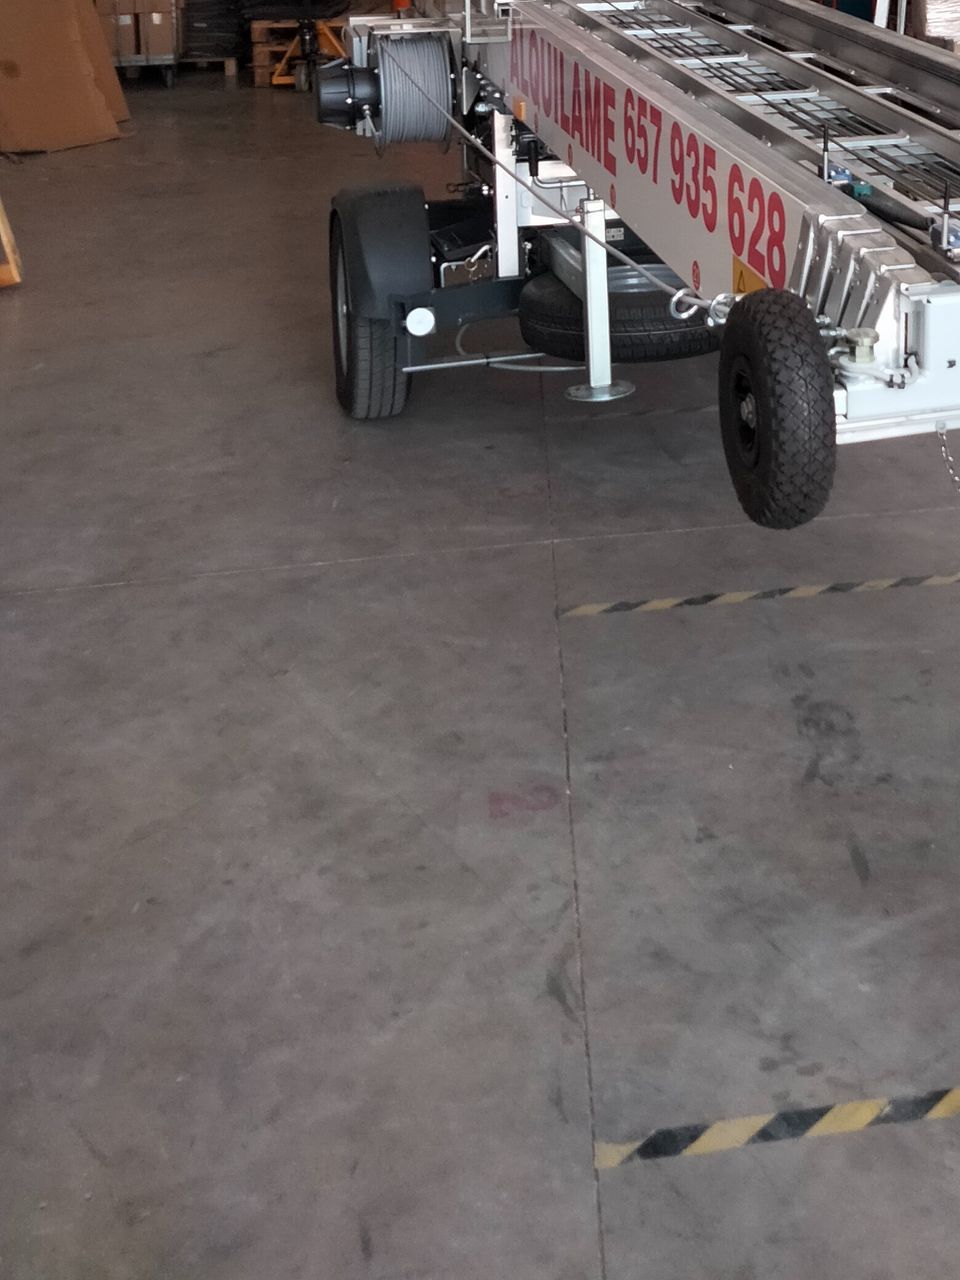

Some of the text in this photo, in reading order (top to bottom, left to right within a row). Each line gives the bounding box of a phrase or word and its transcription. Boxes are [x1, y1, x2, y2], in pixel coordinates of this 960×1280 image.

[510, 22, 787, 290] ALQUILAME 657 935 628
